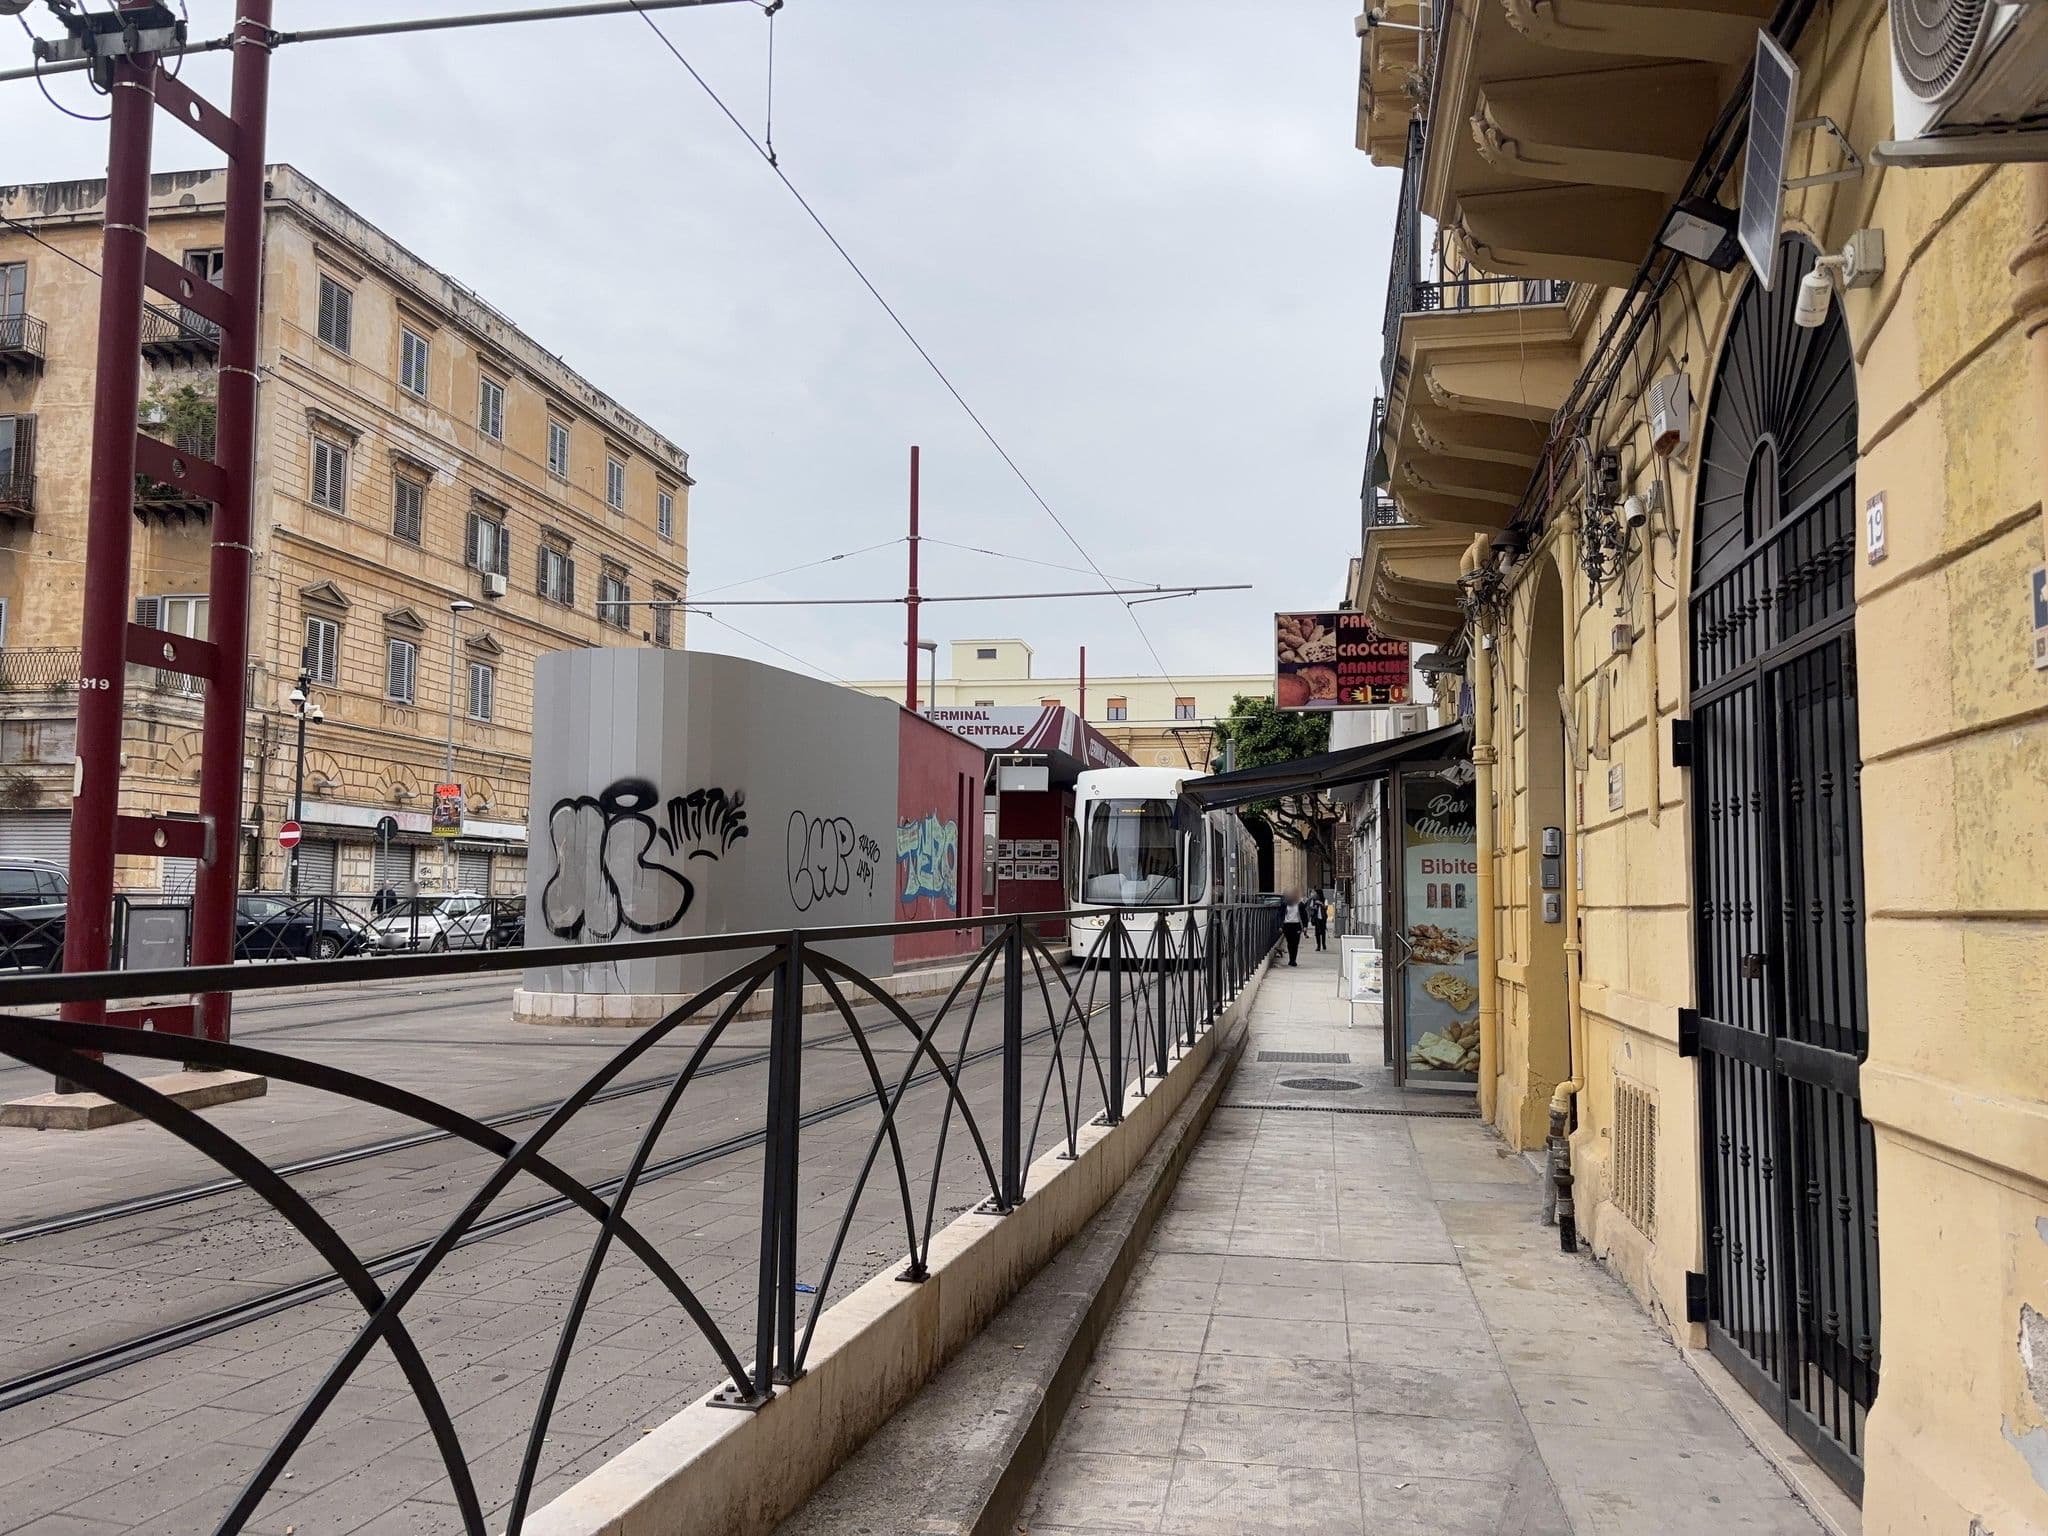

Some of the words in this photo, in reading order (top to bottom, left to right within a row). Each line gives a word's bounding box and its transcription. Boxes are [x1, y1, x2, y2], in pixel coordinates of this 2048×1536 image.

[1868, 508, 1882, 547] 19
[1366, 629, 1377, 642] &
[1338, 642, 1408, 656] CROCCHE
[81, 678, 110, 690] 319
[924, 711, 989, 721] TERMINAL
[957, 725, 1025, 735] CENTRALE
[1428, 794, 1469, 817] Bar
[1414, 817, 1476, 845] Marily
[1421, 859, 1478, 875] Bibite
